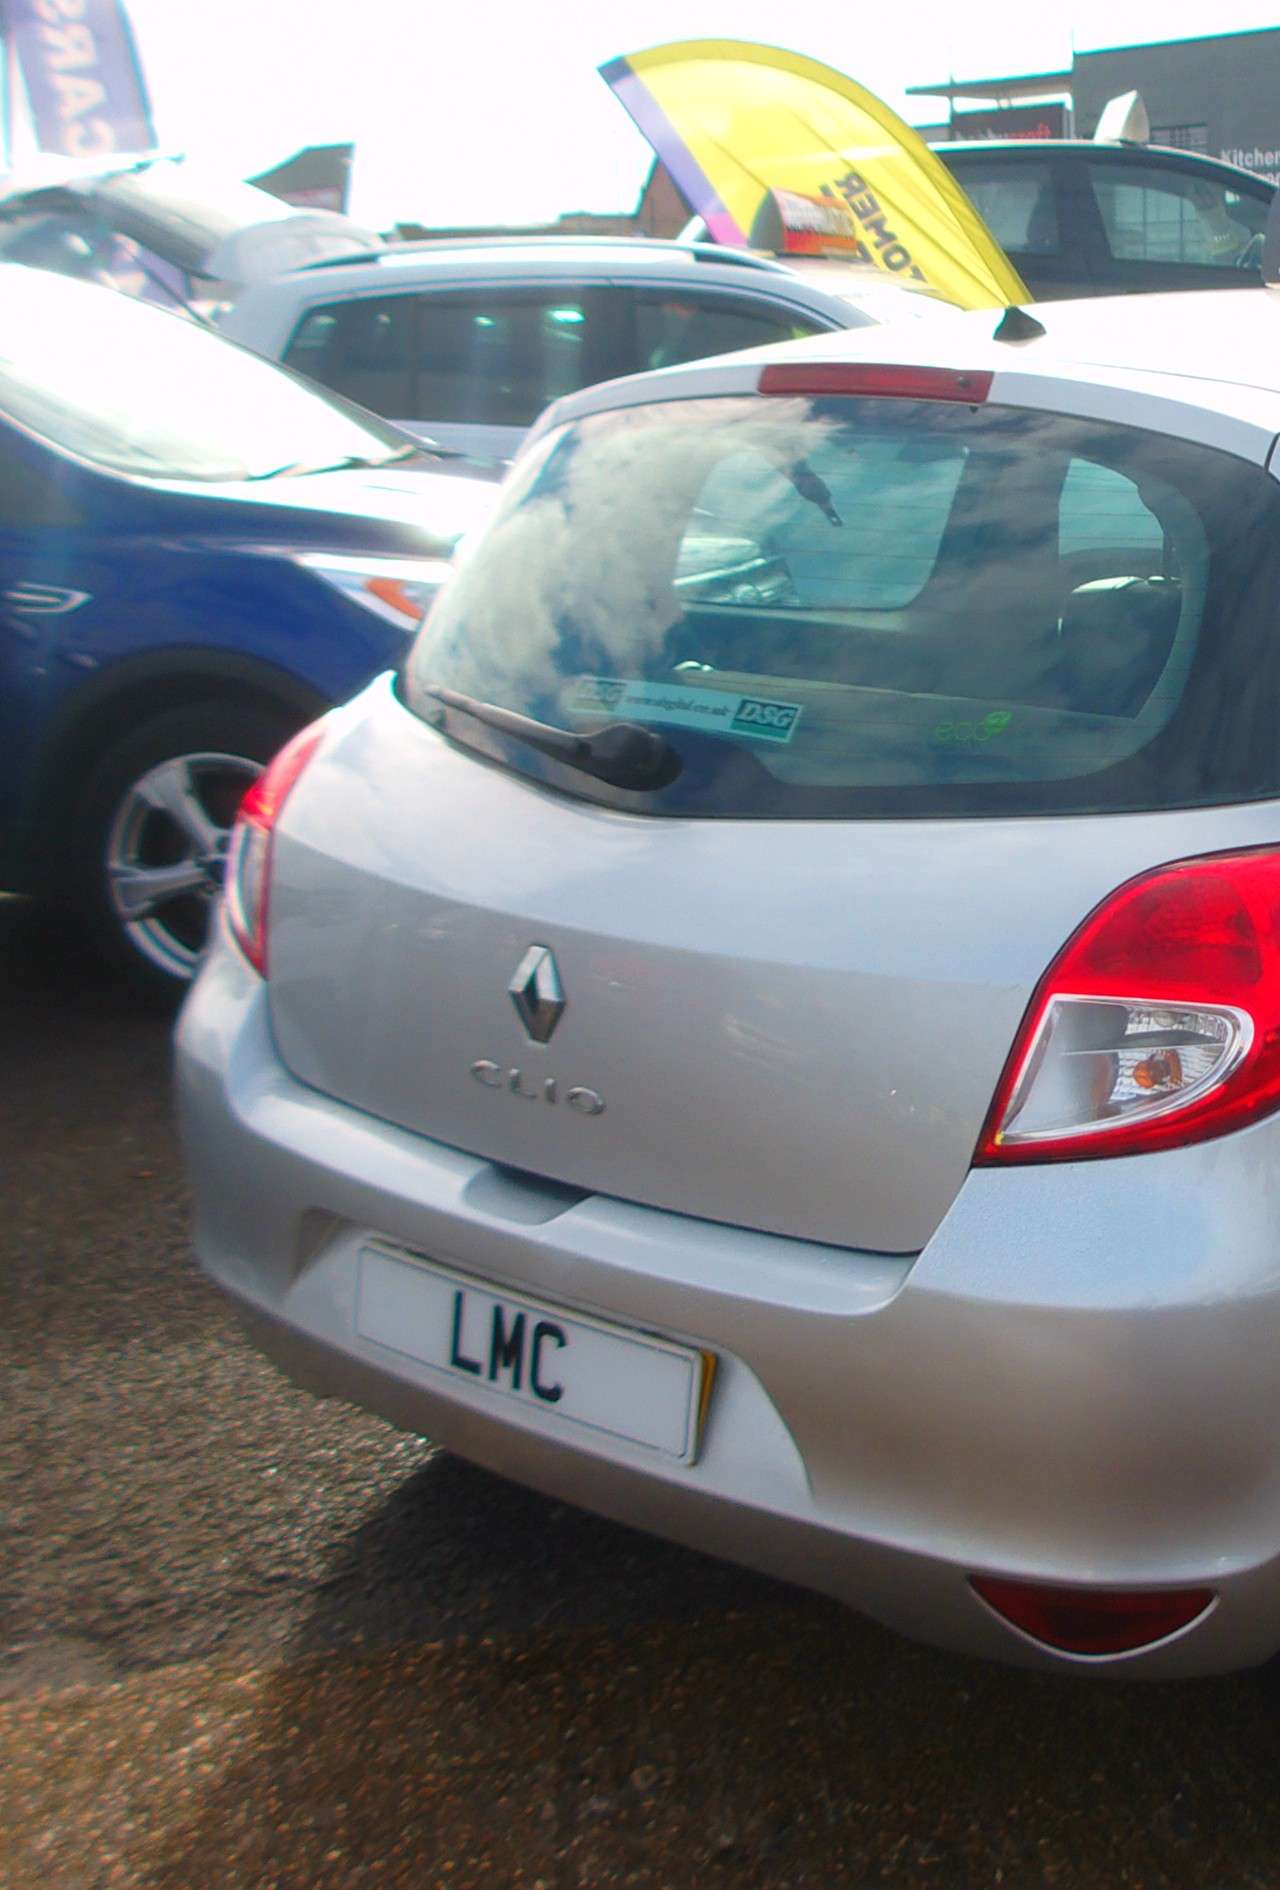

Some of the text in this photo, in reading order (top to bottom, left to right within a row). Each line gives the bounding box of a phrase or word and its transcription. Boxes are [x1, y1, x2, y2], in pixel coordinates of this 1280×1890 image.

[739, 701, 797, 729] DSG
[470, 1059, 607, 1115] CLIO
[450, 1291, 569, 1404] LMC
